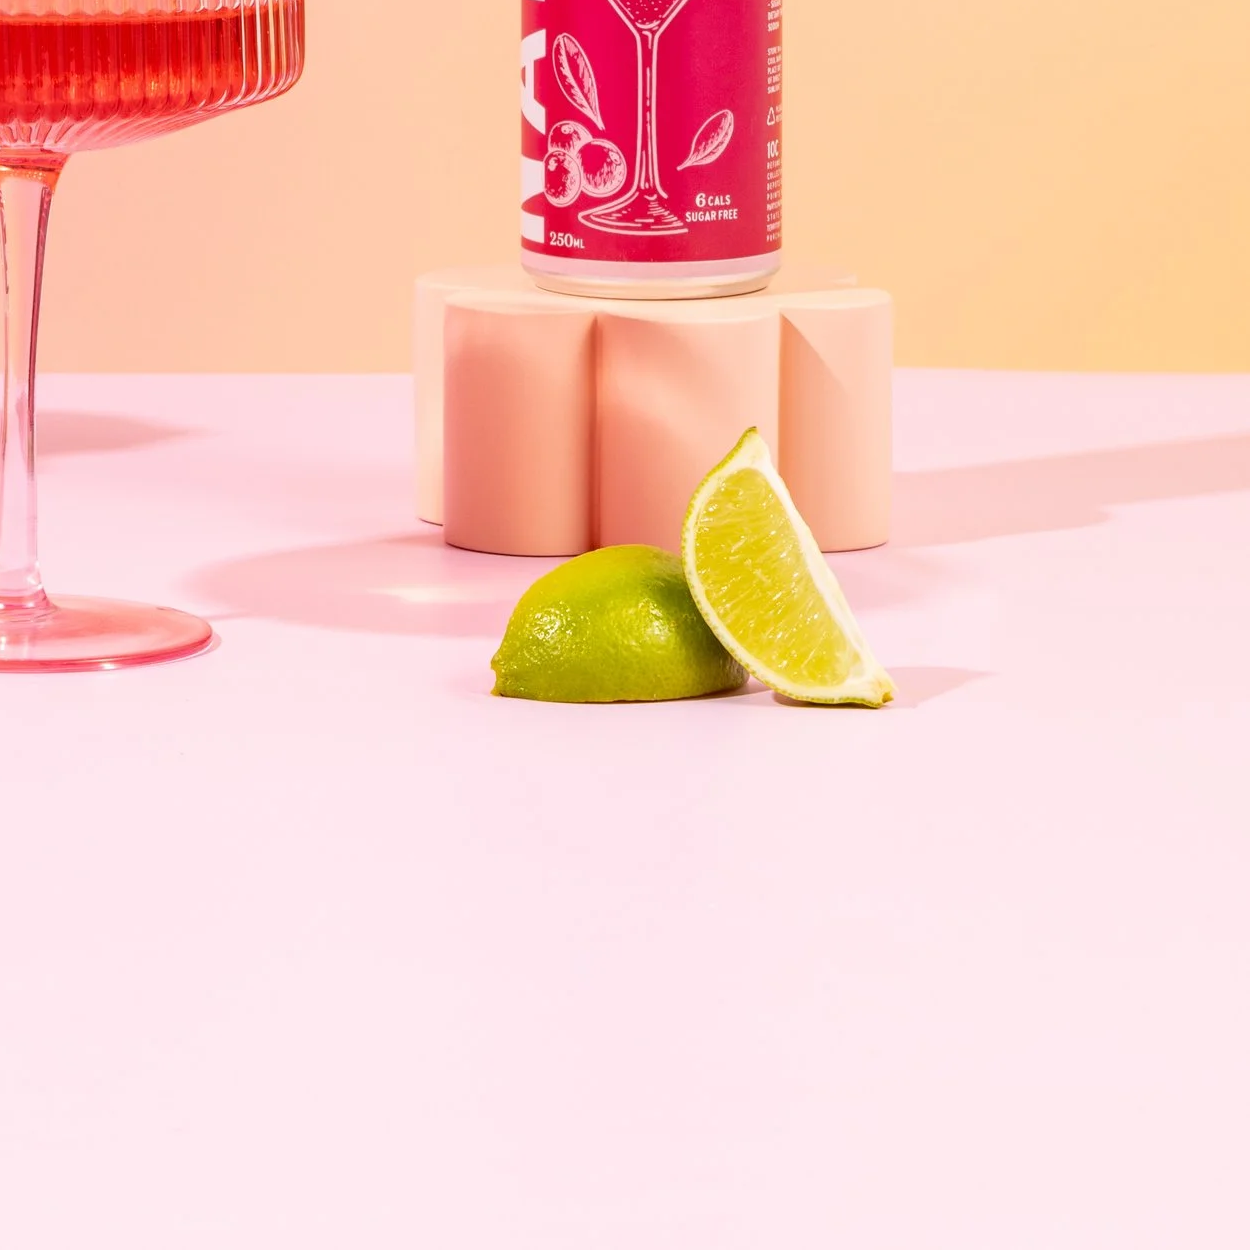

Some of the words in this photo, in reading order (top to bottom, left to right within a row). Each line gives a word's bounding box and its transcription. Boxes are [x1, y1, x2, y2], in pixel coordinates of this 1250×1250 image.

[695, 193, 706, 207] 6
[707, 194, 731, 206] CALS
[685, 210, 717, 222] SUGAR
[718, 209, 738, 221] FREE
[549, 232, 585, 249] 250ML
